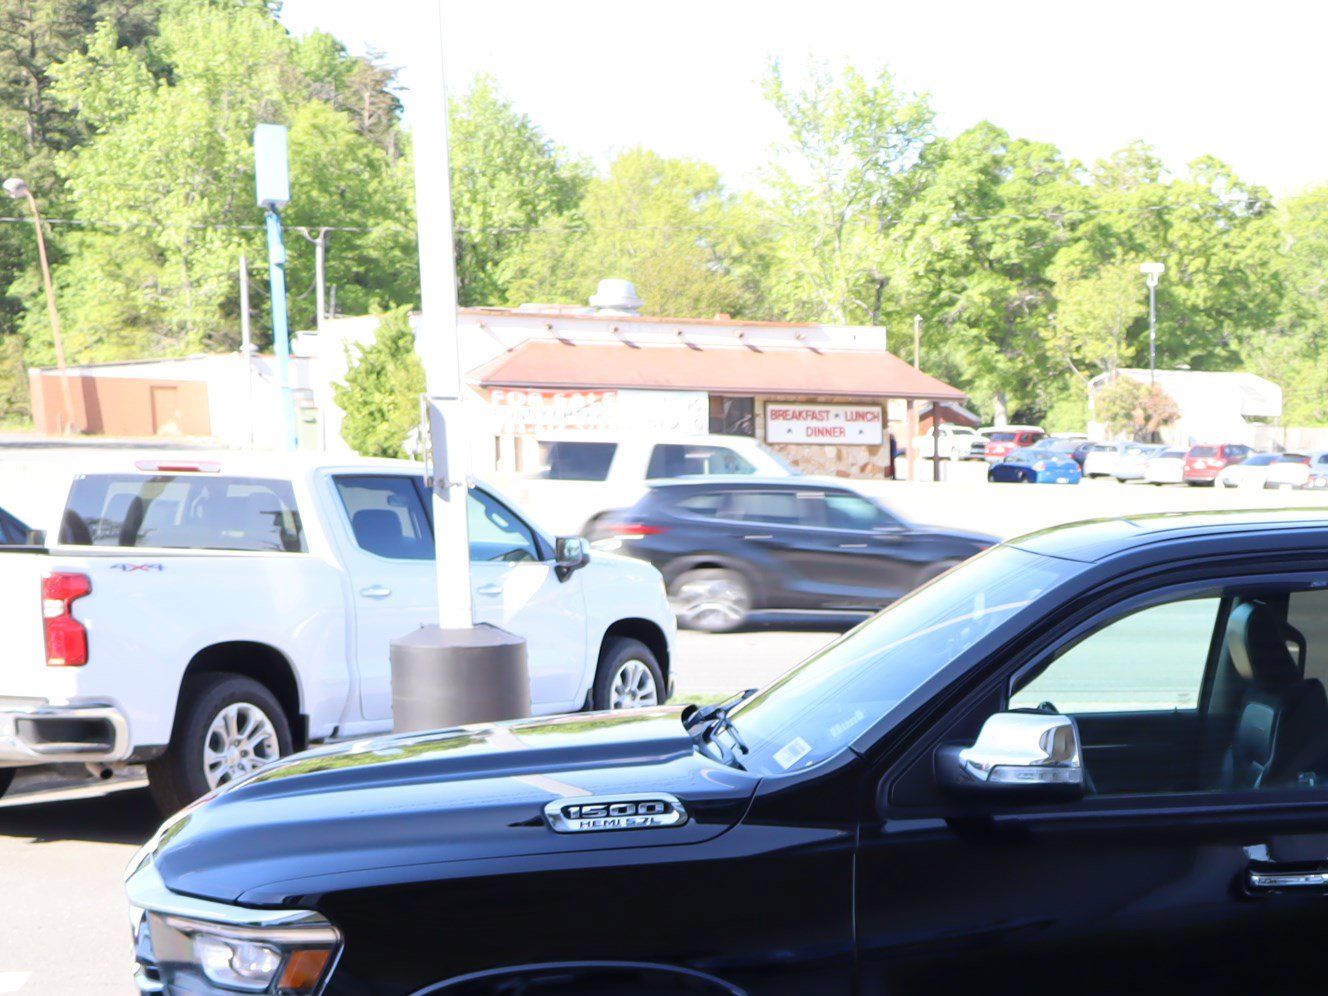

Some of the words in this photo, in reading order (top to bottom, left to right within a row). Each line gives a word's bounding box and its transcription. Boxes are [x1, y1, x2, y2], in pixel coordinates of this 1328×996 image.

[491, 390, 543, 406] FOR
[770, 409, 831, 421] BREAKFAST
[844, 410, 880, 423] LUNCH
[805, 426, 846, 438] DINNER
[567, 801, 665, 820] 1500
[579, 819, 622, 829] HEMI
